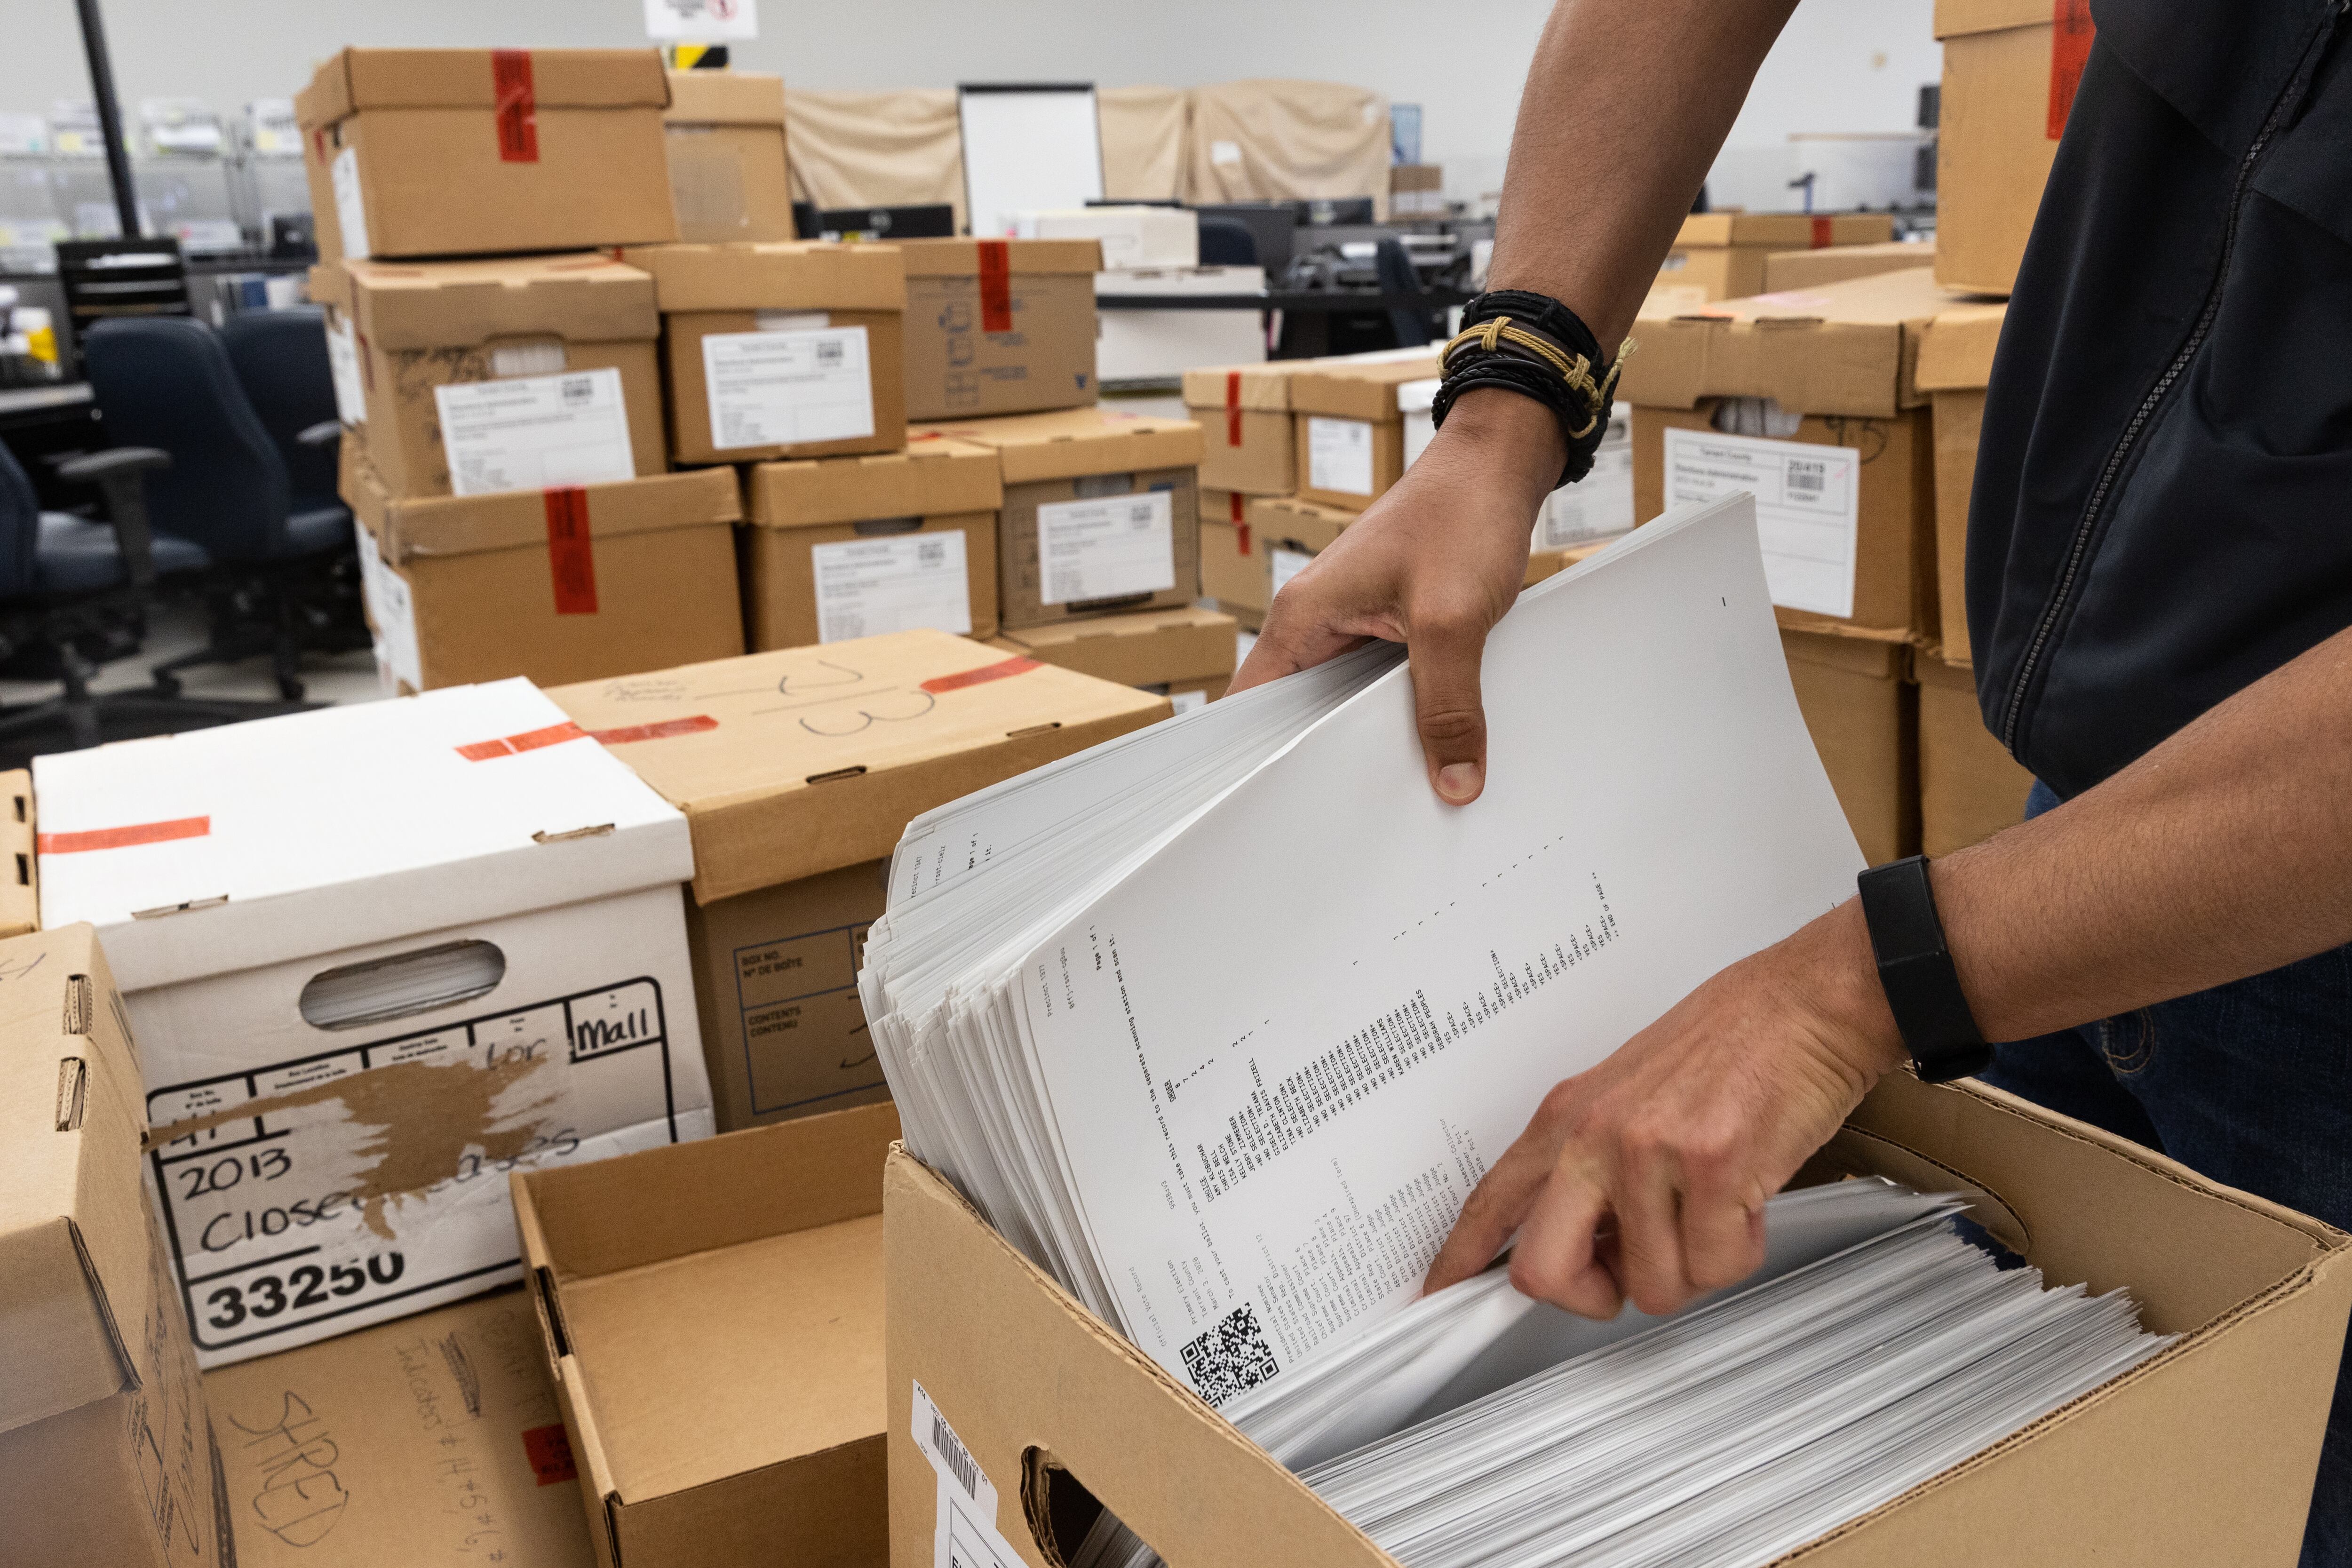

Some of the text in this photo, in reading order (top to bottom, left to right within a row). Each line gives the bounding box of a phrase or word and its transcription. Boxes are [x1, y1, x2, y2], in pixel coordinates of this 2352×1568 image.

[1595, 883, 1605, 900] PAGE
[748, 1006, 801, 1025] CONTENTS
[1042, 982, 1053, 1017] Precinct
[1120, 985, 1131, 1014] station
[1128, 1016, 1141, 1050] scanning
[1415, 989, 1445, 1050] DEBORAH PEOPLES
[1447, 1011, 1460, 1038] <SPACE>
[1376, 1018, 1404, 1075] KAREN WILLIAMS
[1138, 1053, 1152, 1086] separate
[1164, 1080, 1176, 1102] ORDER
[1248, 1057, 1288, 1151] ELIZABETH DAVIS FRIZELL
[1286, 1076, 1313, 1134] ELIZABETH BECK
[1154, 1104, 1160, 1114] to
[1251, 1090, 1280, 1156] GISELA D. TRIANA
[1272, 1095, 1295, 1145] TINA CLINTON
[1157, 1115, 1170, 1140] record
[1229, 1115, 1255, 1171] JERRY ZIMMERER
[1168, 1143, 1177, 1160] this
[1218, 1143, 1239, 1186] LISA WELCH
[1225, 1133, 1247, 1179] KELLY STONE
[1330, 1157, 1343, 1178] Term)
[1439, 1119, 1471, 1187] Assessor-Collector
[179, 1148, 292, 1200] 2013
[1176, 1162, 1184, 1180] take
[1197, 1143, 1221, 1196] AMY KLOBUCHAR
[1210, 1149, 1230, 1191] CHRIS BELL
[1183, 1182, 1193, 1200] must
[1199, 1176, 1214, 1202] CHOICE
[1340, 1180, 1362, 1220] (Unexpired
[200, 1191, 369, 1251] Close
[1191, 1202, 1200, 1215] you
[1255, 1233, 1263, 1243] 12
[1335, 1215, 1346, 1236] Place
[1349, 1225, 1366, 1258] District
[1363, 1231, 1375, 1252] Place
[1192, 1257, 1204, 1274] 2020
[1211, 1250, 1222, 1266] your
[1262, 1245, 1279, 1279] District
[1299, 1255, 1311, 1276] Place
[1315, 1243, 1327, 1265] Place
[1367, 1214, 1400, 1287] 48th District Judge
[207, 1251, 405, 1329] 33250
[1167, 1259, 1198, 1325] Primary Election
[1181, 1261, 1208, 1318] Tarrant County
[1219, 1268, 1230, 1285] cast
[1359, 1273, 1376, 1305] Criminal
[1373, 1279, 1384, 1299] State
[1383, 1280, 1393, 1294] 2nd
[1128, 1266, 1167, 1347] Official Vote Record
[1207, 1288, 1219, 1310] March
[1228, 1288, 1234, 1299] To
[1280, 1264, 1319, 1346] Railroad Commissioner
[1292, 1264, 1327, 1339] Chief Supreme Court
[1337, 1293, 1352, 1322] Supreme
[1257, 1284, 1295, 1363] Presidential Nominee
[1264, 1276, 1303, 1358] United States Senator
[1286, 1299, 1299, 1325] States
[1321, 1305, 1335, 1334] Supreme
[1296, 1326, 1311, 1352] United
[941, 1417, 946, 1428] 05
[962, 1447, 968, 1458] 08
[982, 1474, 987, 1486] 01
[228, 1390, 349, 1548] SHRED
